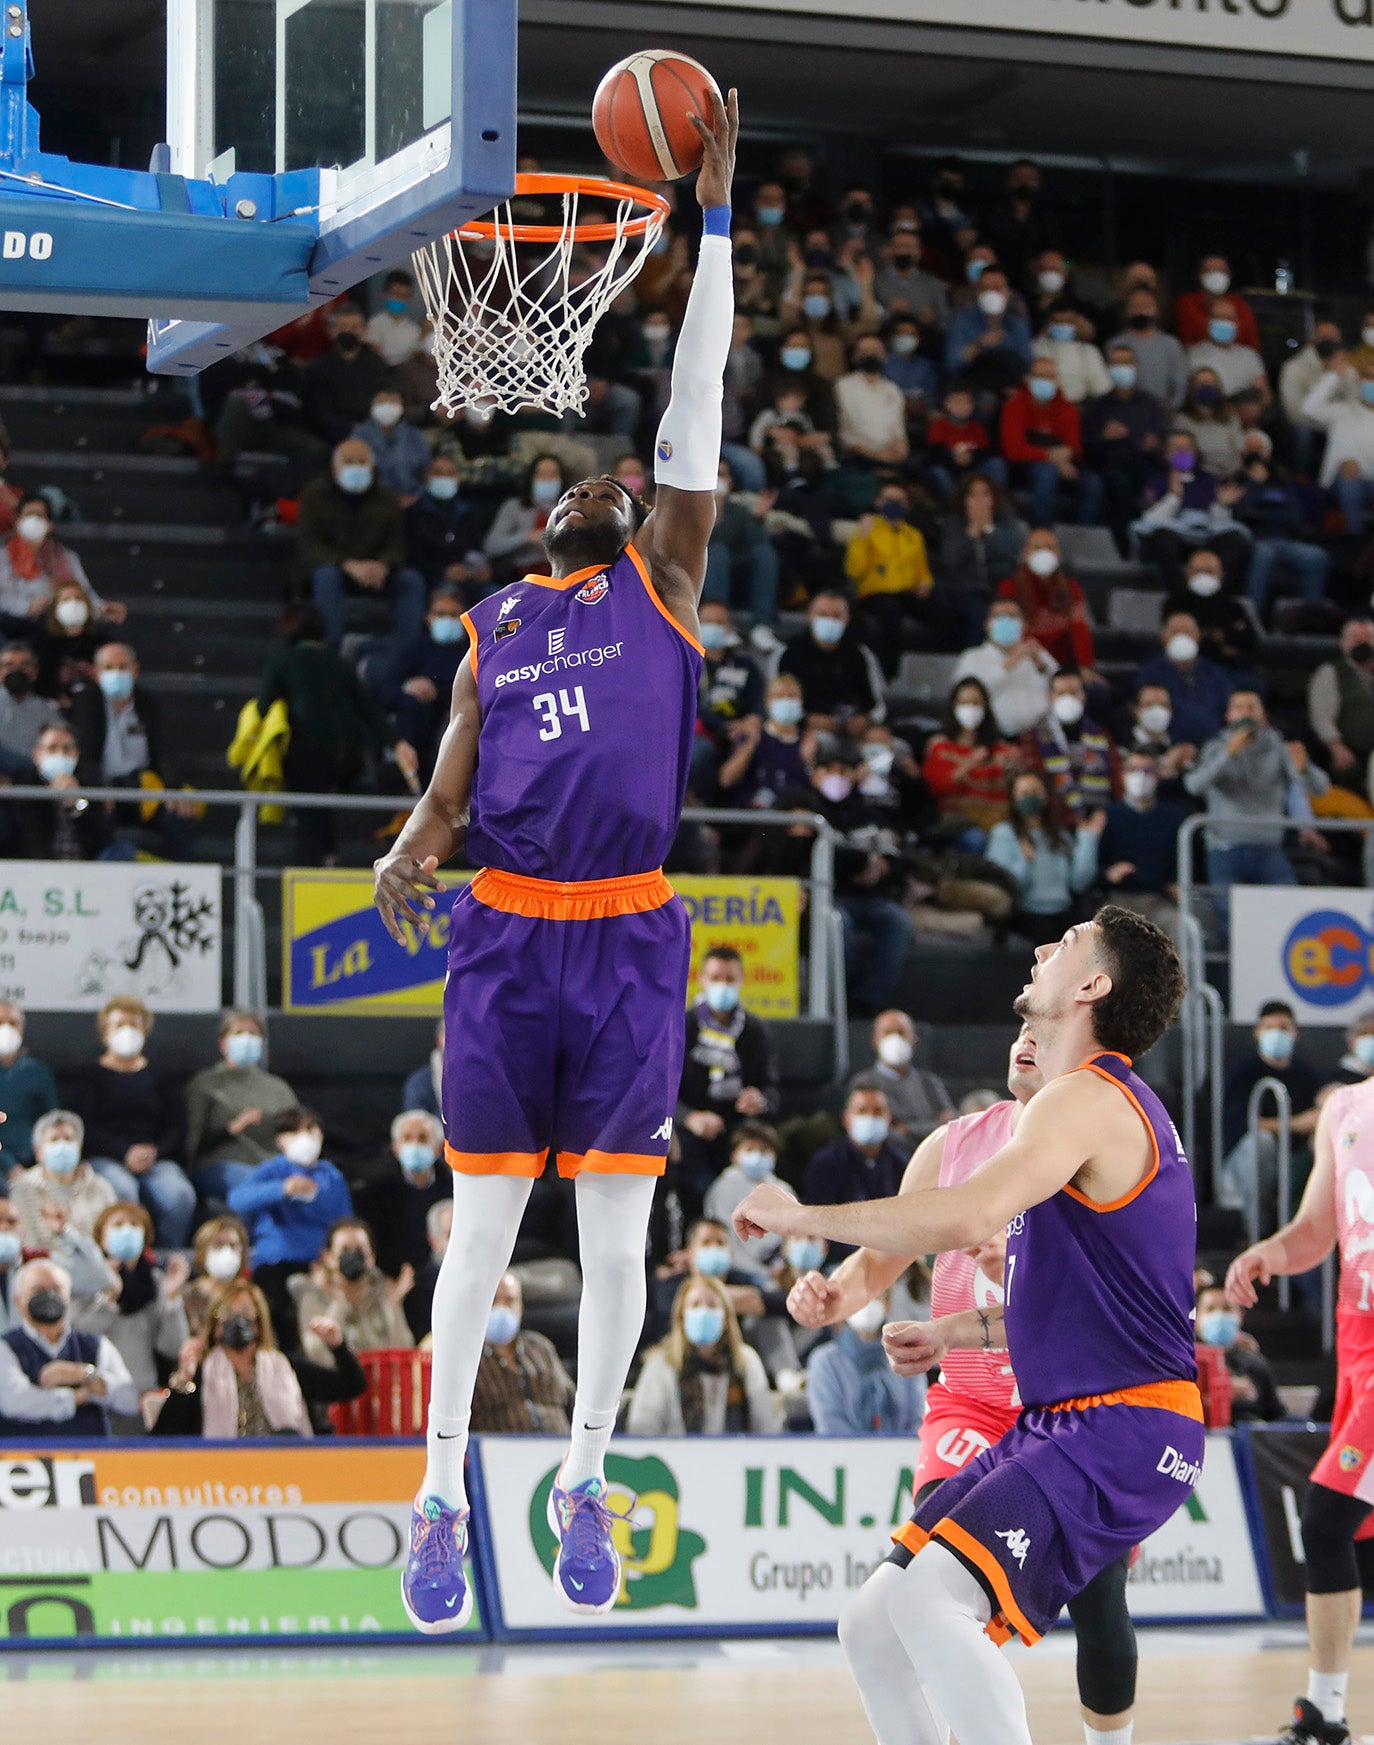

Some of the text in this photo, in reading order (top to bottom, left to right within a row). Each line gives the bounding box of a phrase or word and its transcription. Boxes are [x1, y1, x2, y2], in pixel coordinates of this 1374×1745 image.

[494, 642, 624, 688] easycharger
[532, 685, 591, 742] 34
[310, 911, 450, 989] La Ve
[101, 1480, 304, 1508] consultores
[749, 1550, 833, 1601] Grupo
[110, 1614, 383, 1636] INGENIERIA
